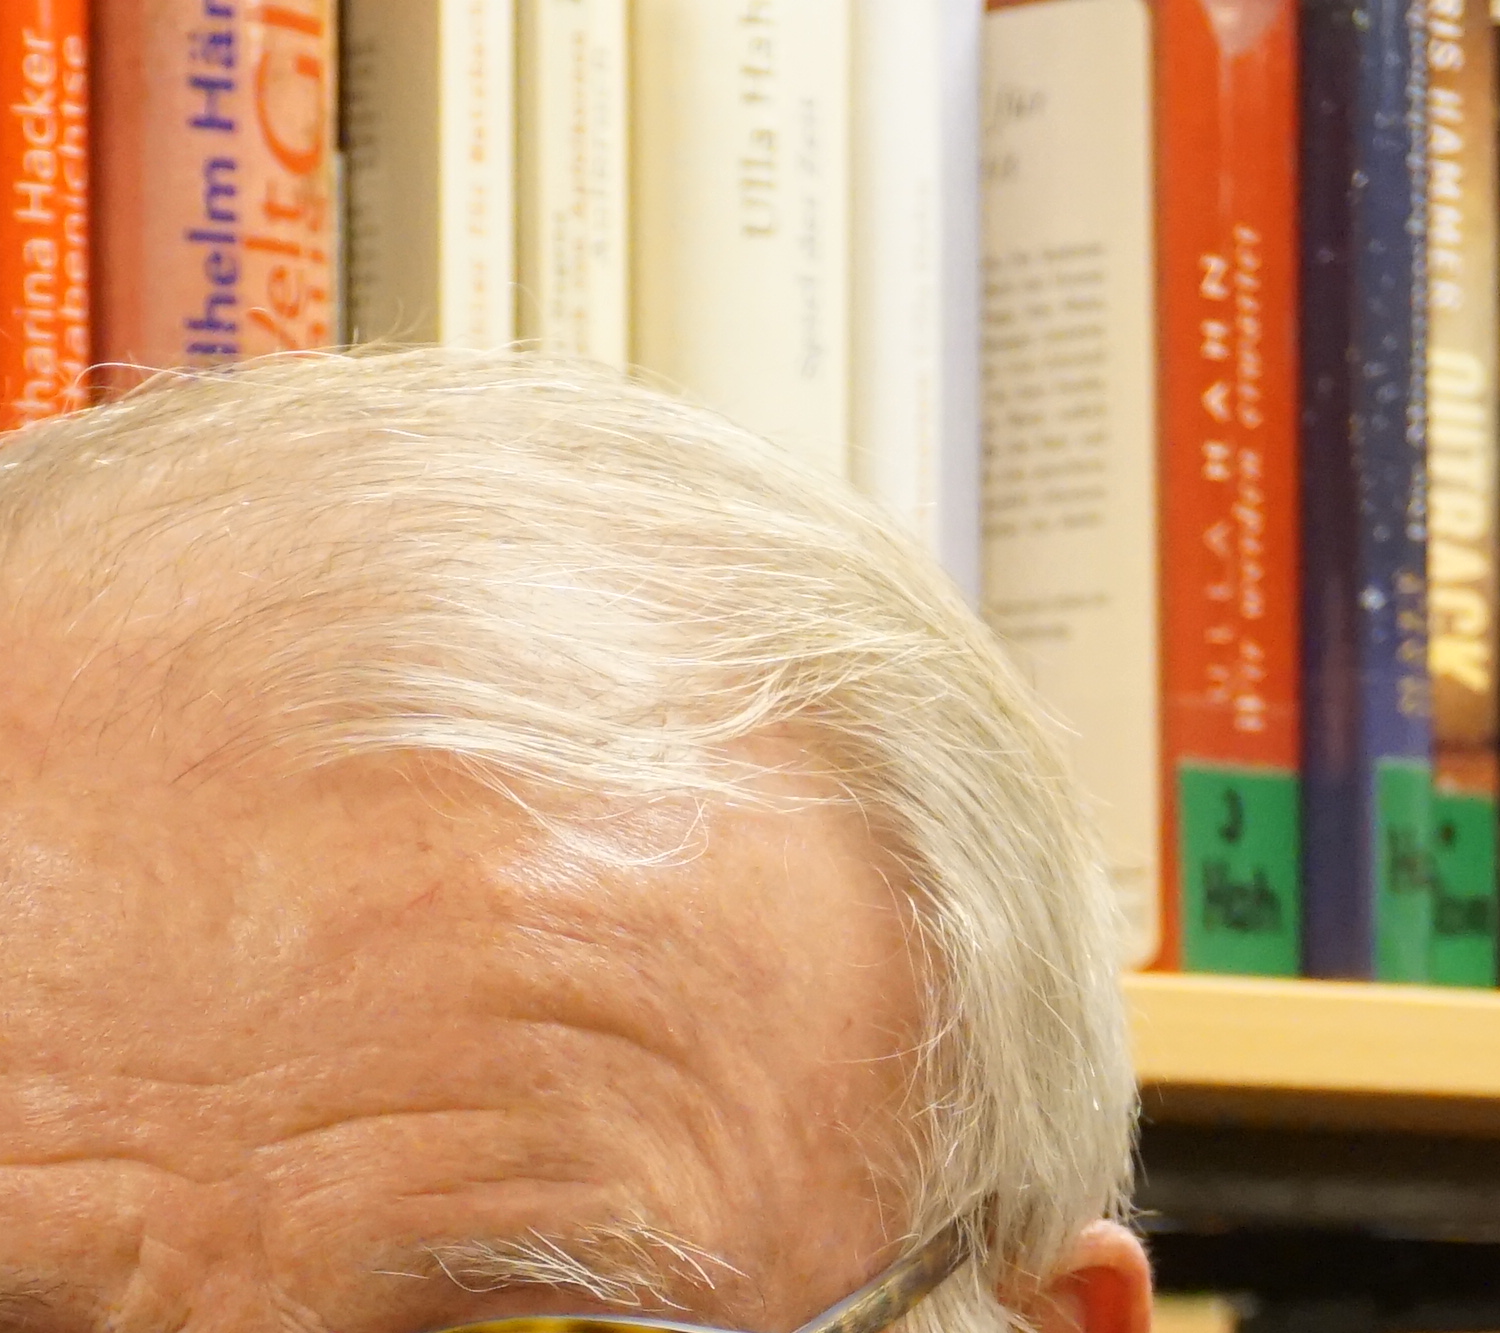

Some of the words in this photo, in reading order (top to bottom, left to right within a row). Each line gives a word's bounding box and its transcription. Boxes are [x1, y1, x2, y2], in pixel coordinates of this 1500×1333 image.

[10, 28, 57, 226] Hacker
[736, 0, 777, 106] Hah
[738, 130, 779, 239] Ulla
[1433, 84, 1467, 312] HAMMER
[1197, 250, 1230, 482] HAHN
